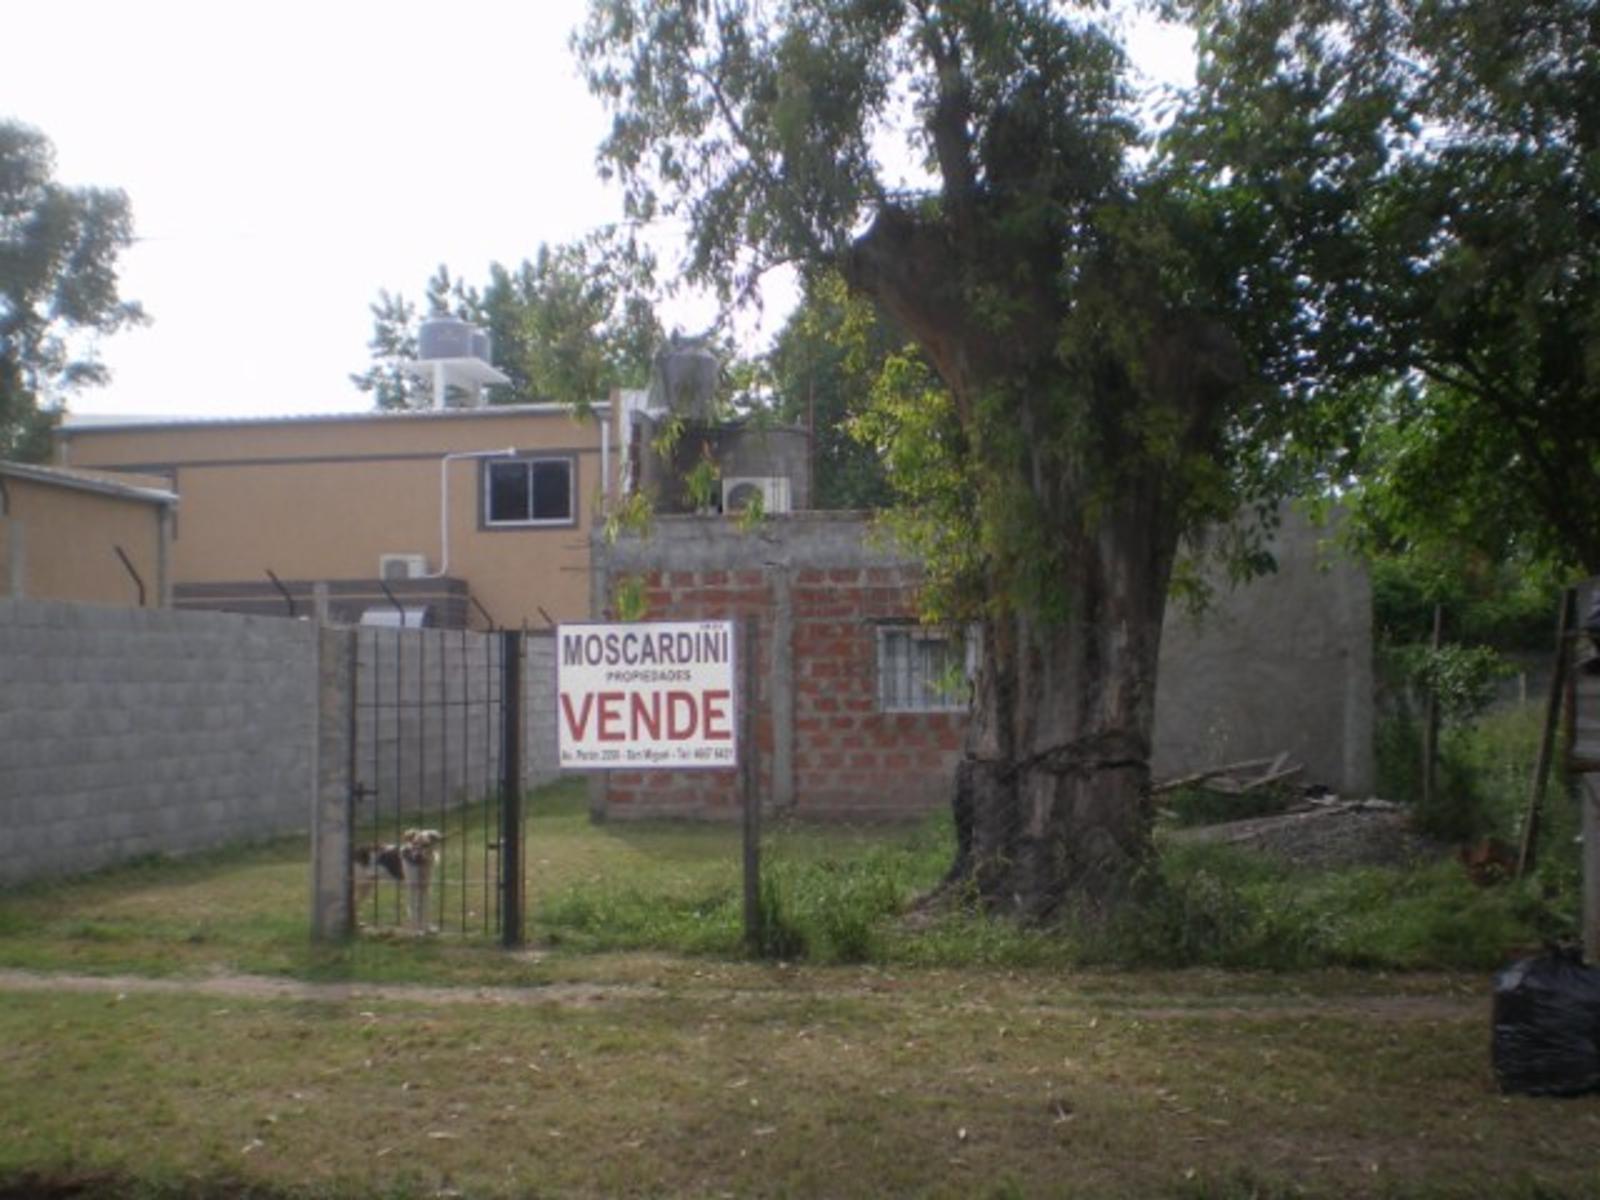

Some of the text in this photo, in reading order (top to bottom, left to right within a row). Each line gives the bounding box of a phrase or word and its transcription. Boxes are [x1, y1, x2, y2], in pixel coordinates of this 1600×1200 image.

[563, 632, 728, 666] MOSCARDINI
[606, 670, 691, 682] PROPIEDADES
[560, 690, 731, 742] VENDE
